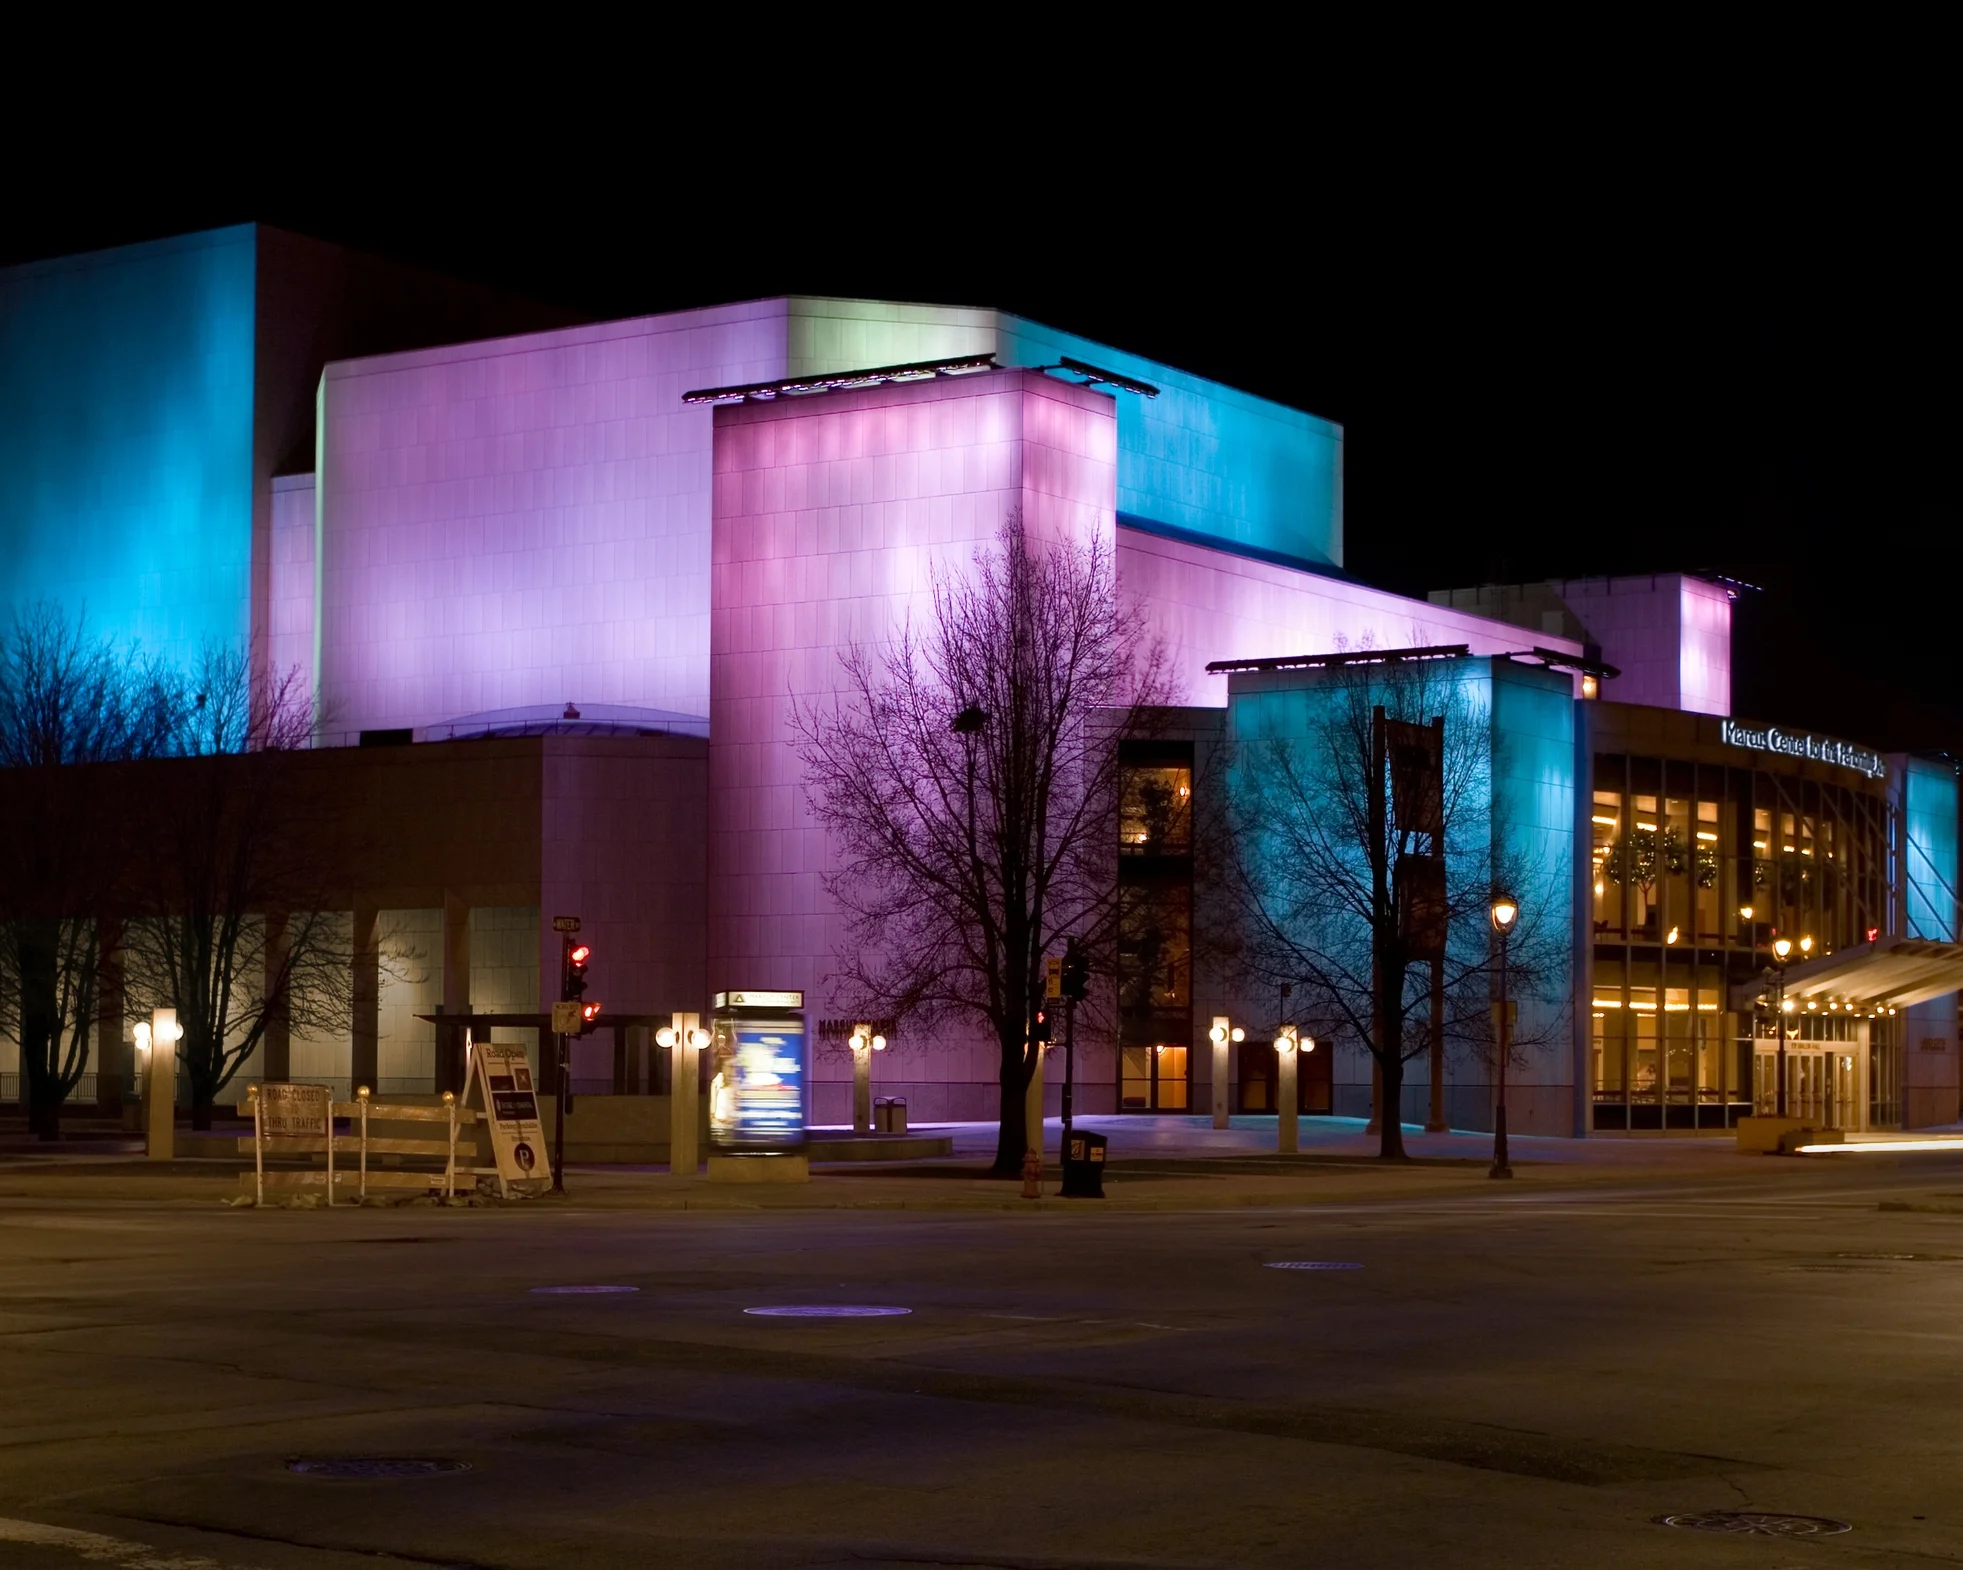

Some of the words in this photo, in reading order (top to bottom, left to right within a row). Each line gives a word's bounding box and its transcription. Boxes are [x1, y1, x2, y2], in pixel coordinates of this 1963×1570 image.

[556, 918, 576, 930] WATER
[486, 1048, 505, 1058] Road
[504, 1048, 525, 1061] Open
[267, 1088, 288, 1101] ROAD
[292, 1089, 320, 1102] CLOSED
[268, 1116, 288, 1129] THRU
[292, 1117, 321, 1130] TRAFFIC
